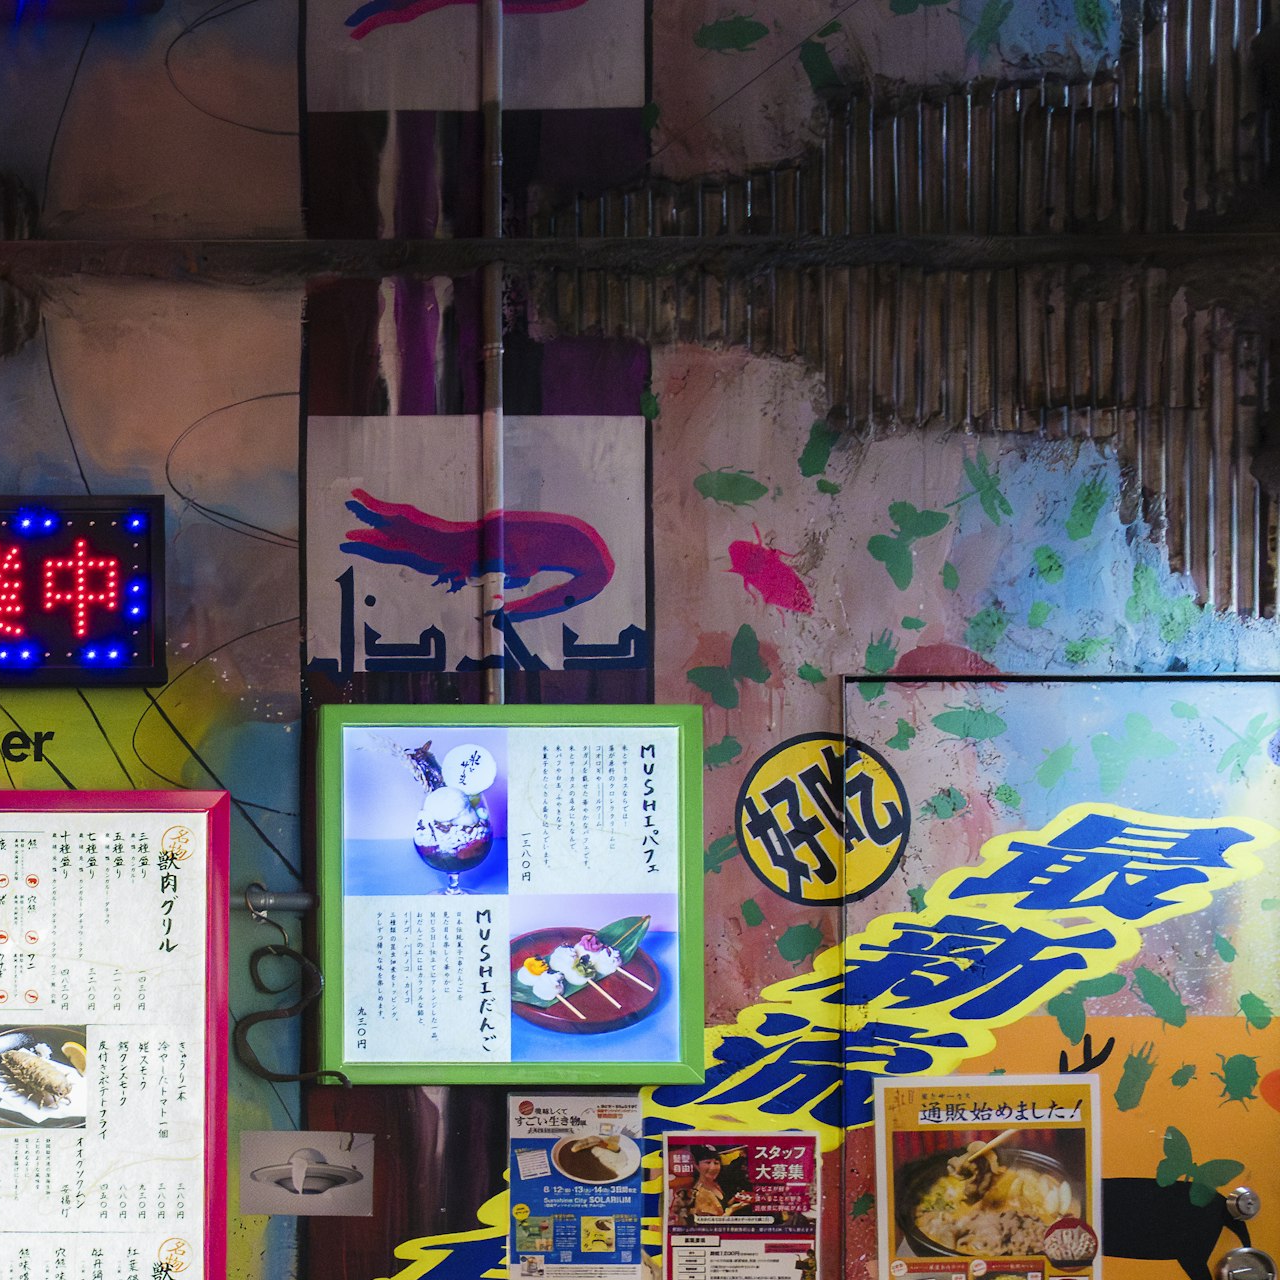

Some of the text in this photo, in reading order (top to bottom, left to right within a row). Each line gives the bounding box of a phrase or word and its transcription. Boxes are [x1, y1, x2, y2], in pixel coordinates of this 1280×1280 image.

[640, 744, 659, 873] MUSHIパフェ
[745, 748, 905, 890] 好吃
[59, 830, 72, 880] 十種盛り
[86, 832, 99, 880] 七種盛り
[112, 832, 125, 879] 五種盛り
[138, 832, 151, 879] 三種盛り
[521, 832, 531, 881] 一三八〇円
[157, 850, 182, 953] 獣肉グリル
[27, 953, 36, 969] ワニ
[476, 909, 496, 1052] MUSHIだんご
[357, 1006, 368, 1049] 九三〇円
[98, 1040, 109, 1140] 皮付きポテトフライ
[176, 1040, 188, 1101] きゅうり一本
[754, 1145, 806, 1159] スタッフ
[755, 1164, 804, 1180] 大募集
[589, 1196, 631, 1204] SOLARIUM
